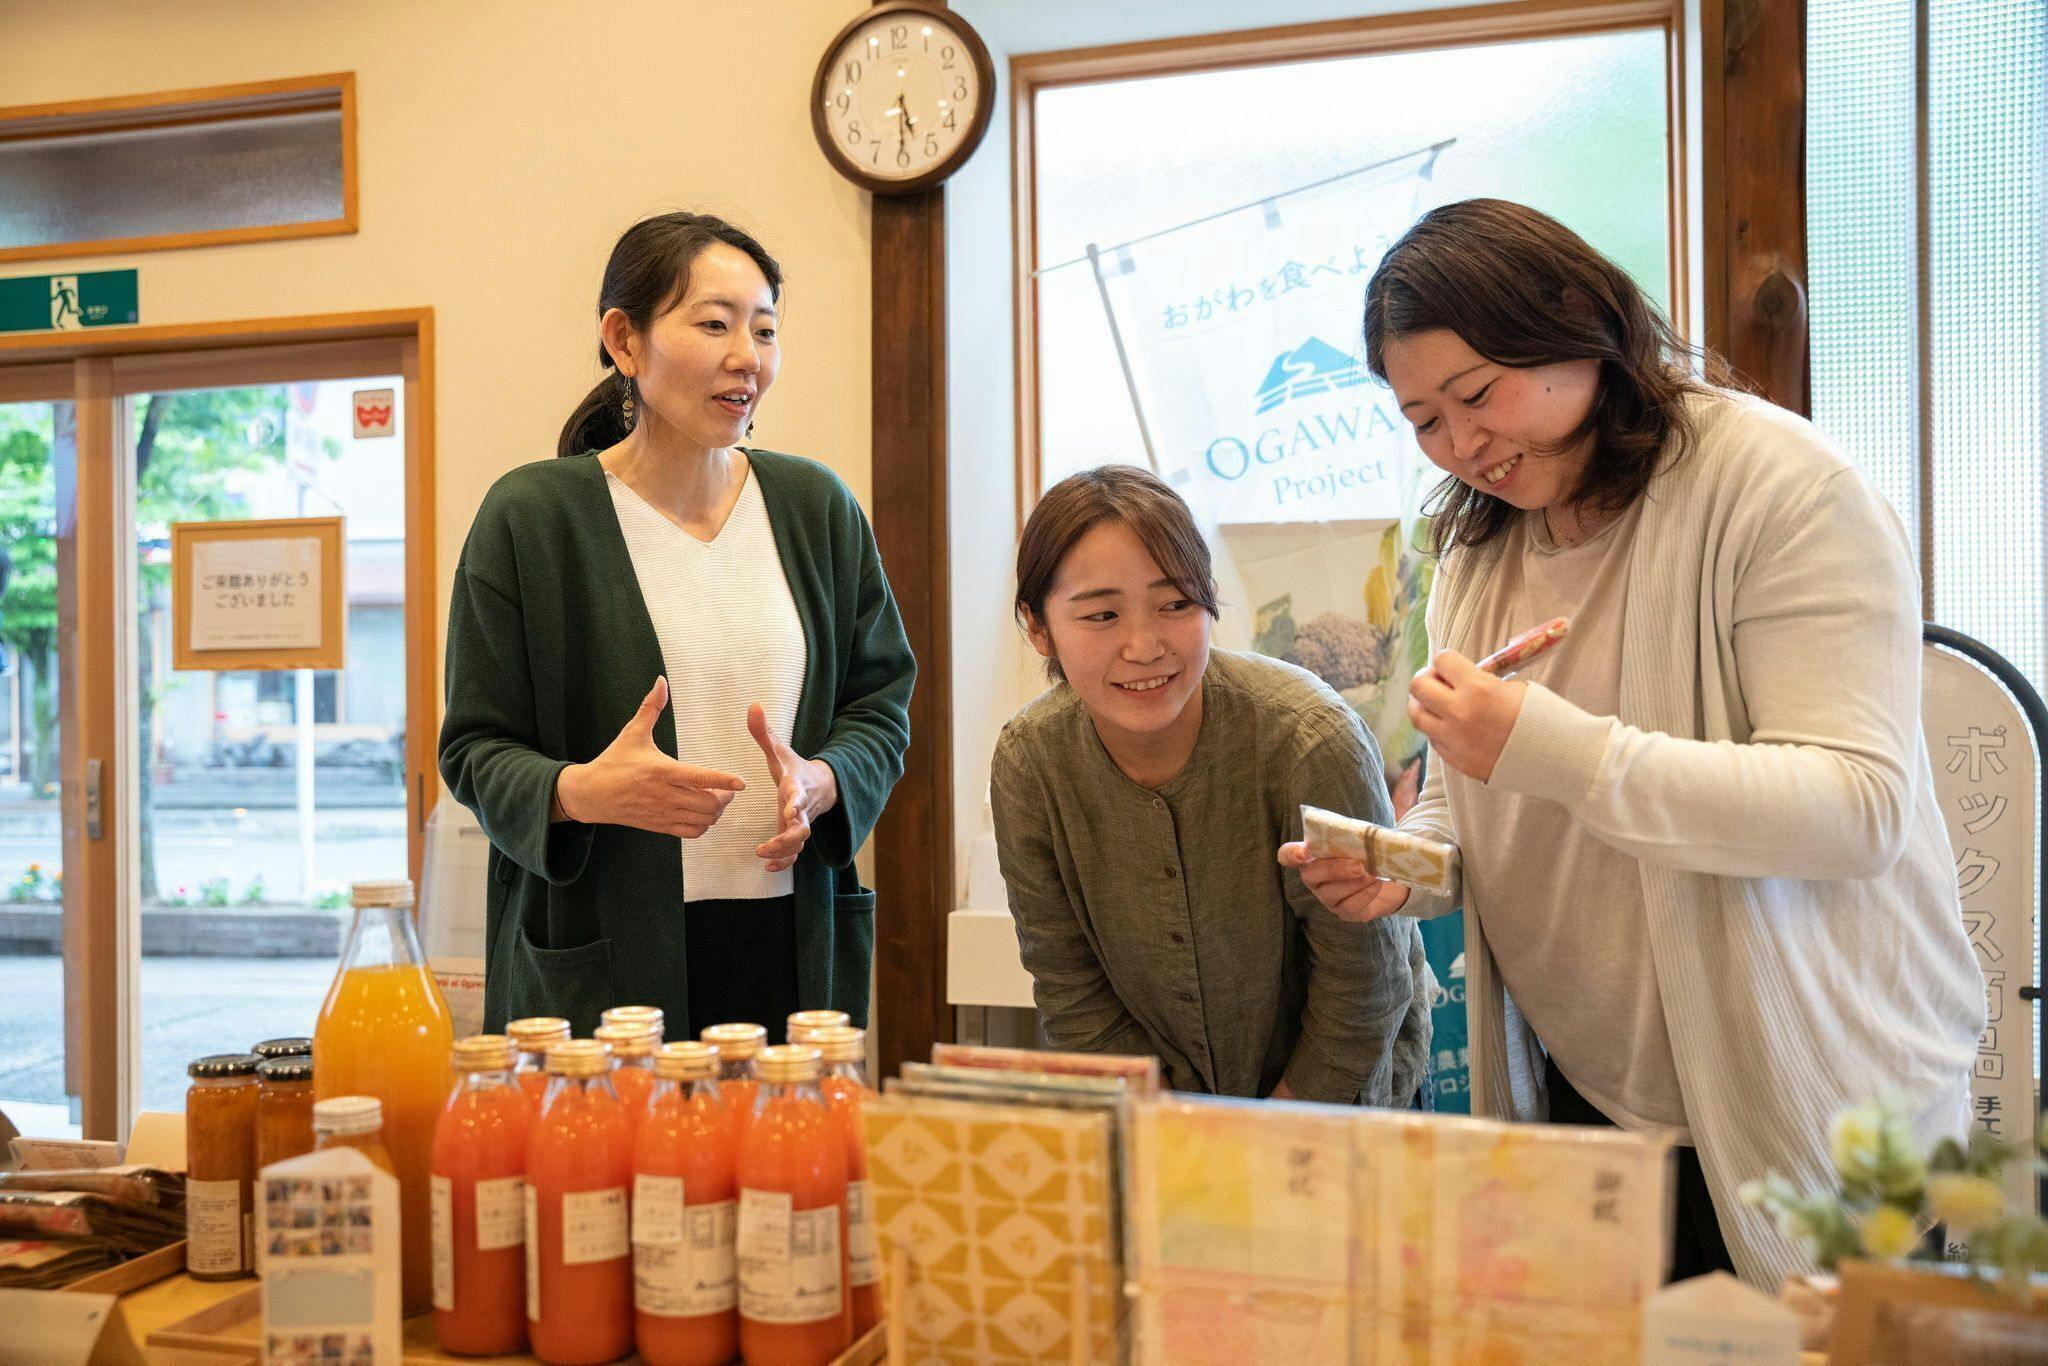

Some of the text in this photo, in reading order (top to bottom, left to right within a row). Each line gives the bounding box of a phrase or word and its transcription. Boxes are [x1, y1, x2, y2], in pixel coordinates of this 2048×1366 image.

[866, 38, 880, 60] 11
[890, 26, 908, 51] 12
[941, 46, 955, 70] 2
[845, 60, 862, 85] 10
[952, 77, 967, 101] 3
[836, 93, 850, 118] 9
[847, 120, 862, 145] 8
[942, 108, 956, 132] 4
[869, 140, 882, 165] 7
[896, 143, 910, 169] 6
[923, 133, 938, 158] 5
[1206, 402, 1396, 480] OGAWA
[1273, 459, 1387, 504] Project
[215, 593, 296, 609] ございました
